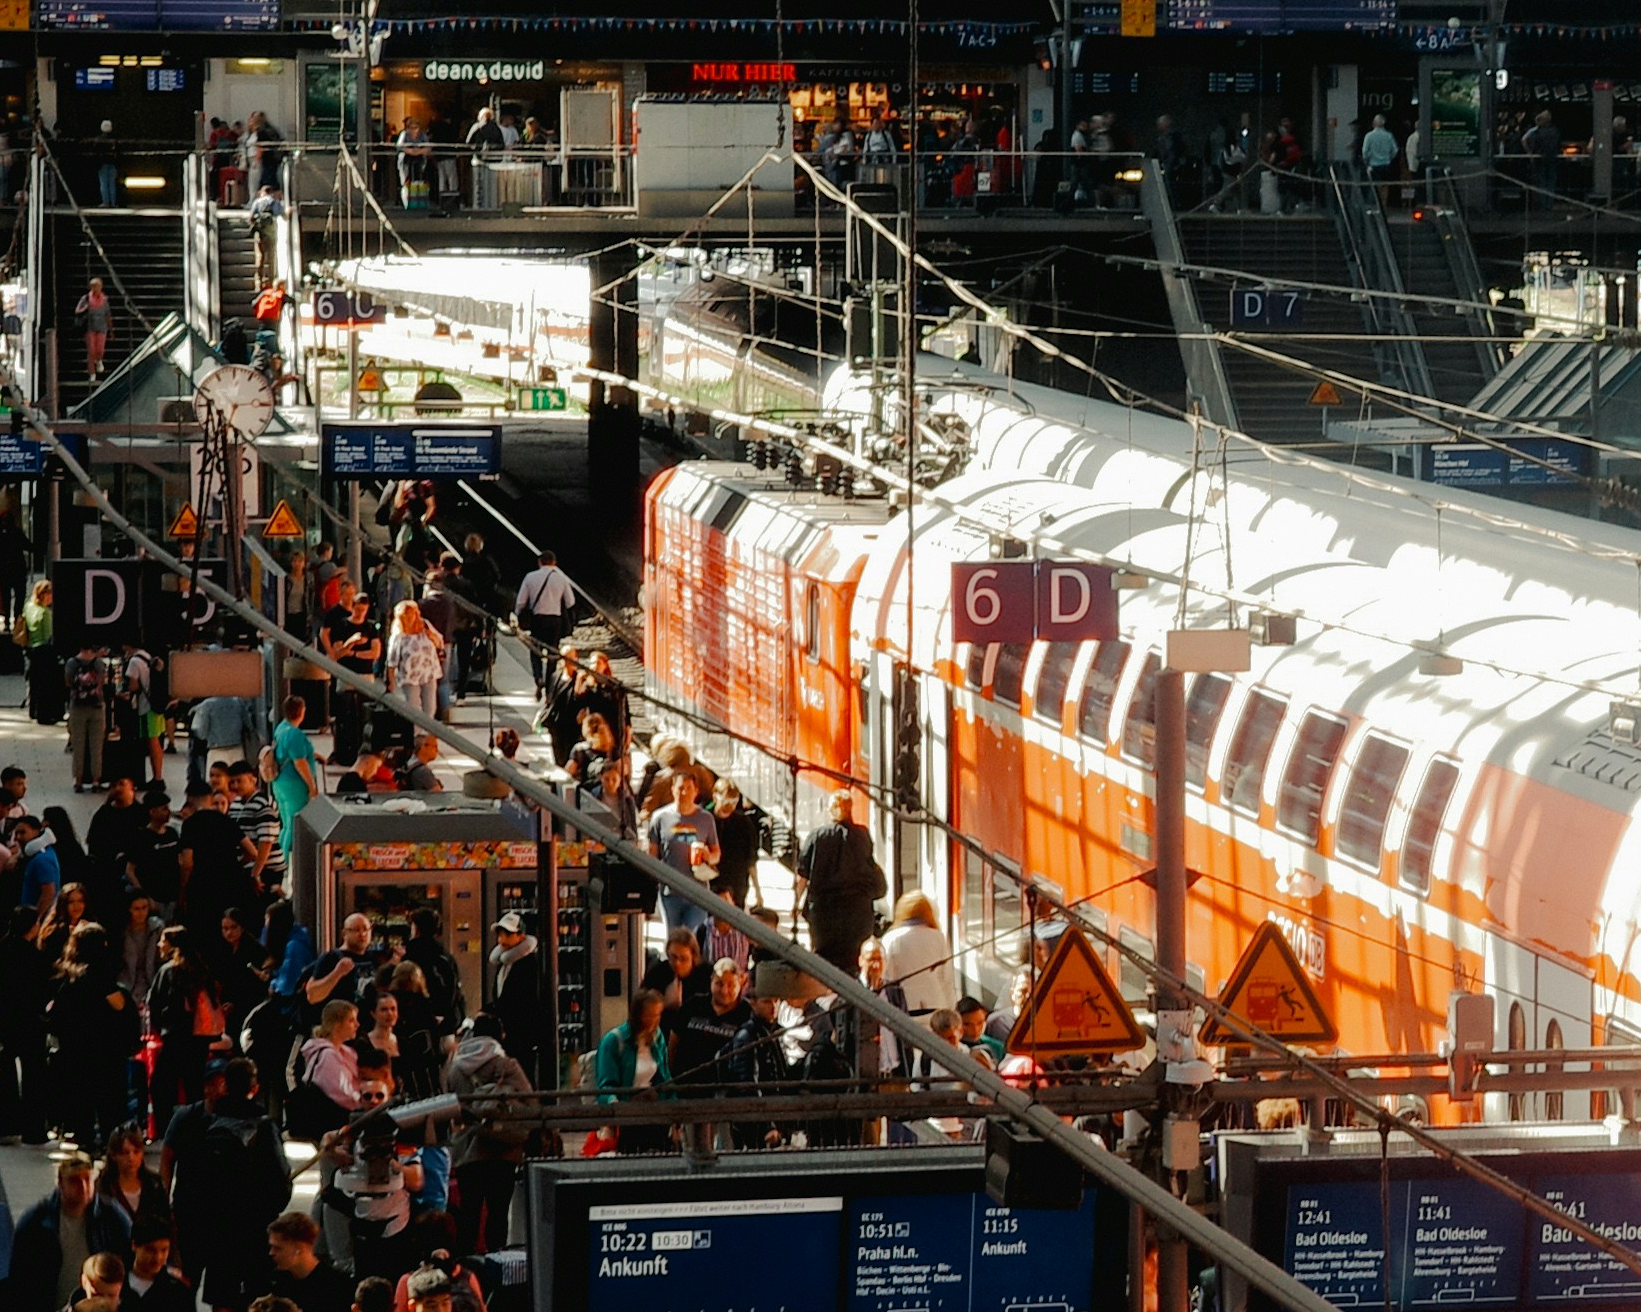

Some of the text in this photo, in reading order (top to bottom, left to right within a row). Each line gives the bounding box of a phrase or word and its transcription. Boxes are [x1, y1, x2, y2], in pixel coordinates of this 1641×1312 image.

[1429, 34, 1437, 50] 8
[690, 62, 798, 82] NUR HIER
[809, 68, 896, 78] KAFFEEWELT
[317, 292, 335, 320] 6
[1242, 292, 1300, 319] D 7
[84, 568, 126, 626] D
[965, 567, 1091, 627] 6 D
[1297, 1210, 1331, 1225] 12:41
[1417, 1206, 1451, 1221] 11:41
[859, 1223, 893, 1239] 10:51
[982, 1218, 1019, 1235] 11:15
[1415, 1226, 1488, 1243] Bad Oldesloe
[600, 1232, 689, 1253] 10:22 10:30
[1295, 1231, 1368, 1247] Bad Oldesloe
[858, 1245, 891, 1261] Praha
[981, 1239, 1028, 1257] Ankunft
[598, 1254, 669, 1278] Ankunft
